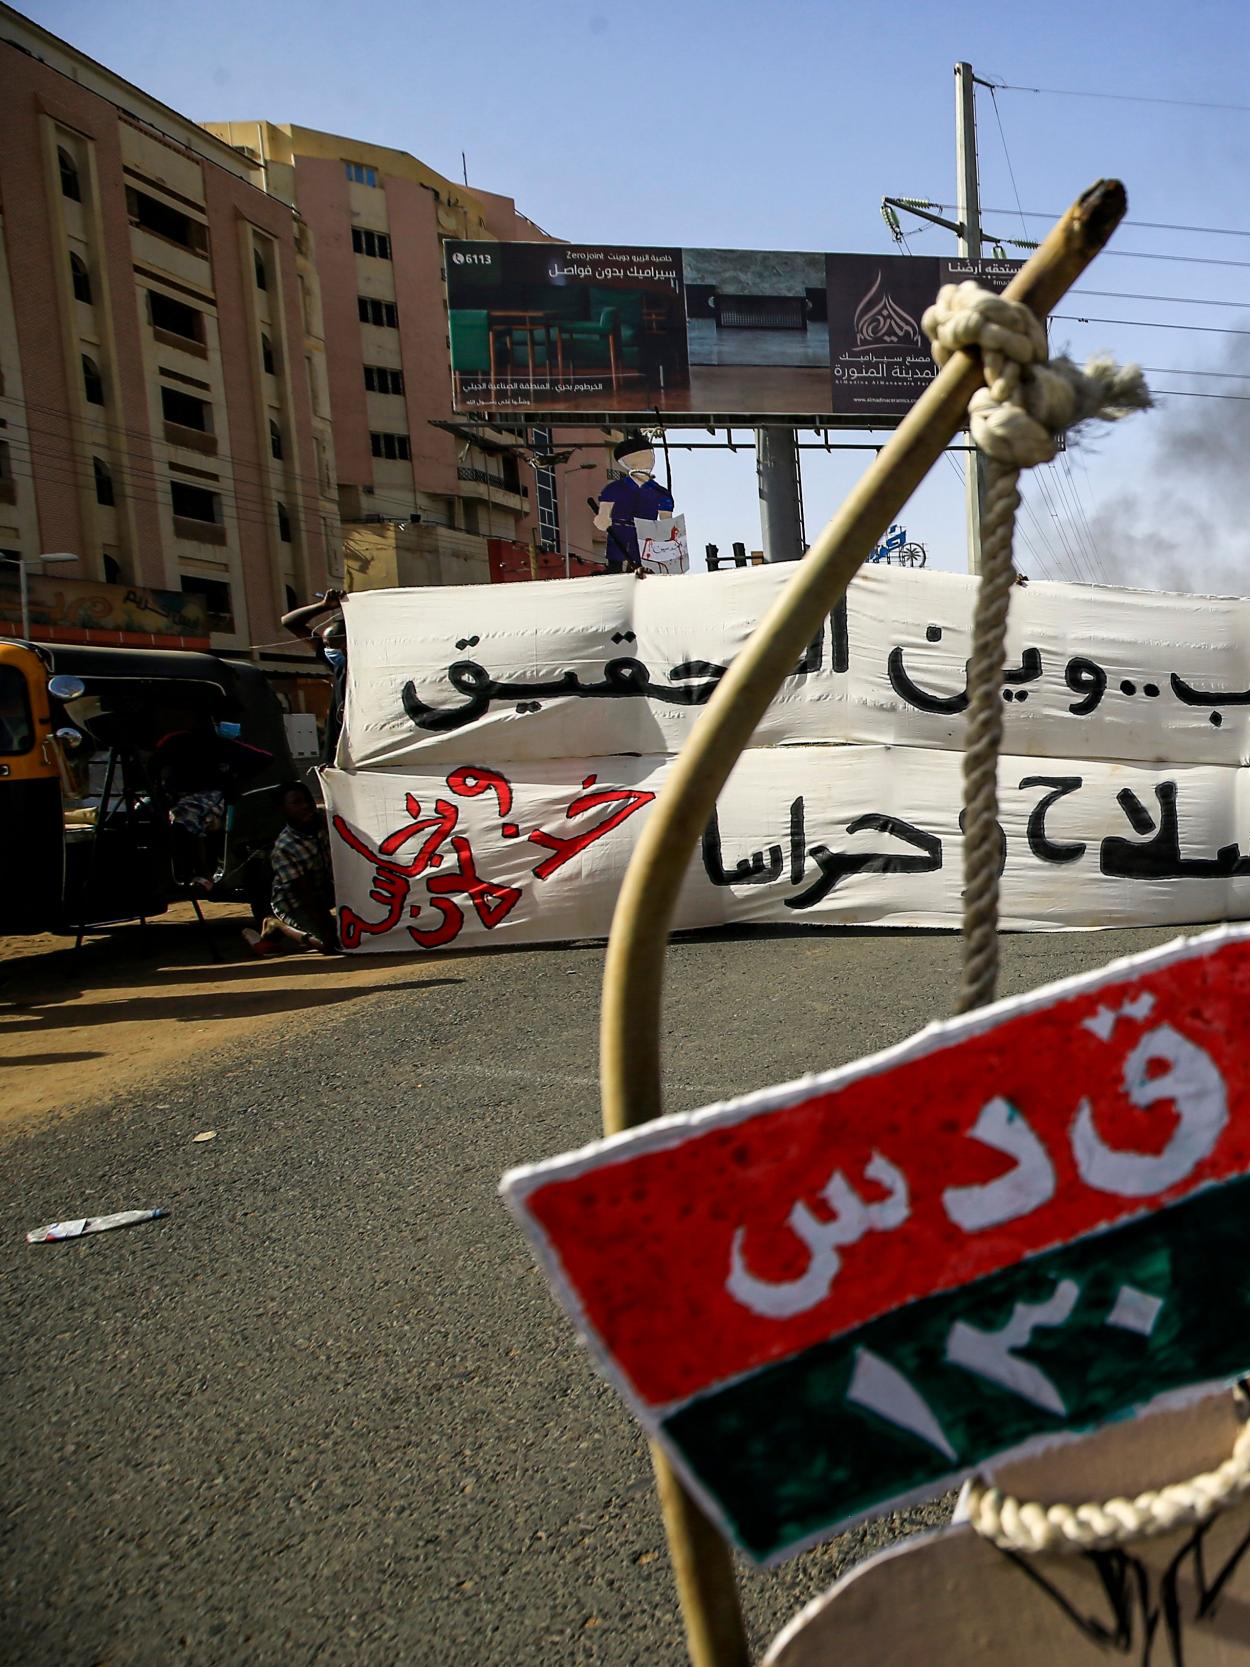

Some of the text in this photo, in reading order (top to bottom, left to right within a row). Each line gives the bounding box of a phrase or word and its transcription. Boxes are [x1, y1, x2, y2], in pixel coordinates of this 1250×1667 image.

[466, 254, 491, 264] 6113
[595, 266, 624, 279] بدون
[905, 355, 931, 365] مصنع
[834, 363, 887, 380] المنورة
